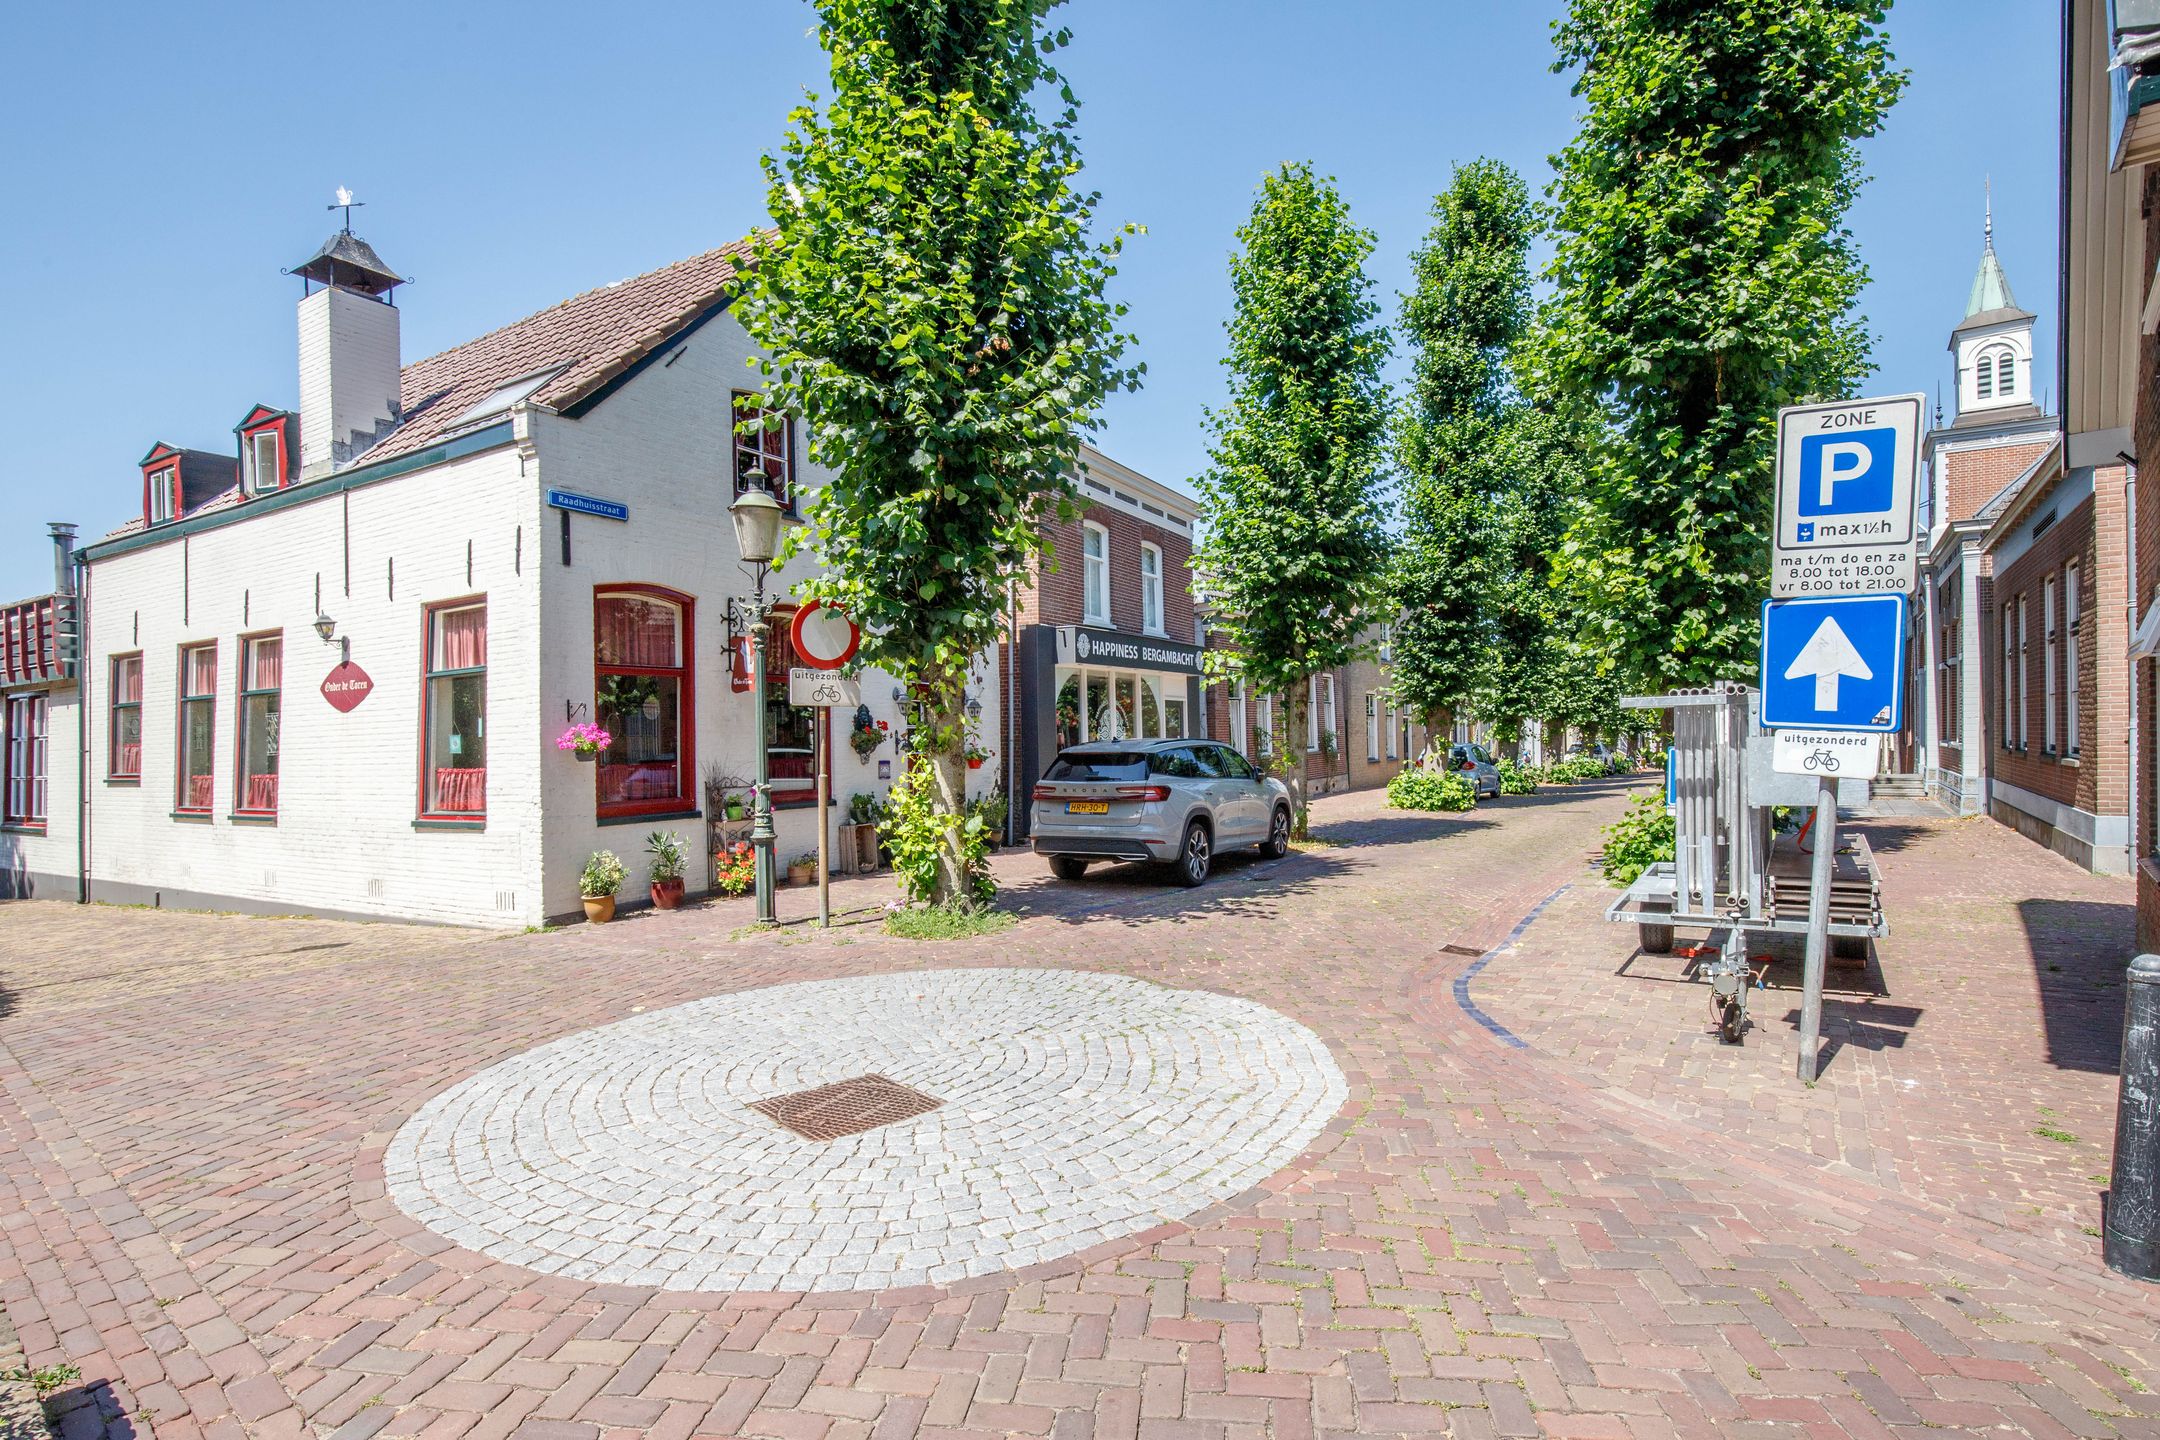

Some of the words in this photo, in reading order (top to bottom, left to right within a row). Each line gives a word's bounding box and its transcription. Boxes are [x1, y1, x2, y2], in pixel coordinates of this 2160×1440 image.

[1821, 410, 1877, 429] ZONE
[1819, 441, 1873, 506] P
[558, 495, 620, 515] Raadhuisstraat
[1781, 557, 1802, 566] ma
[1808, 553, 1835, 566] t/m
[1841, 553, 1859, 564] do
[1864, 554, 1882, 563] en
[1888, 553, 1906, 562] za
[1789, 567, 1822, 579] 8.00
[1828, 567, 1849, 577] tot
[1856, 564, 1895, 576] 18.00
[1779, 583, 1795, 591] vr
[1800, 580, 1833, 591] 8.00
[1839, 579, 1860, 590] tot
[1866, 578, 1906, 589] 21.00
[1092, 640, 1138, 659] HAPPINESS
[1142, 646, 1194, 666] BERGAMBACHT
[1784, 734, 1868, 746] uitgezonderd
